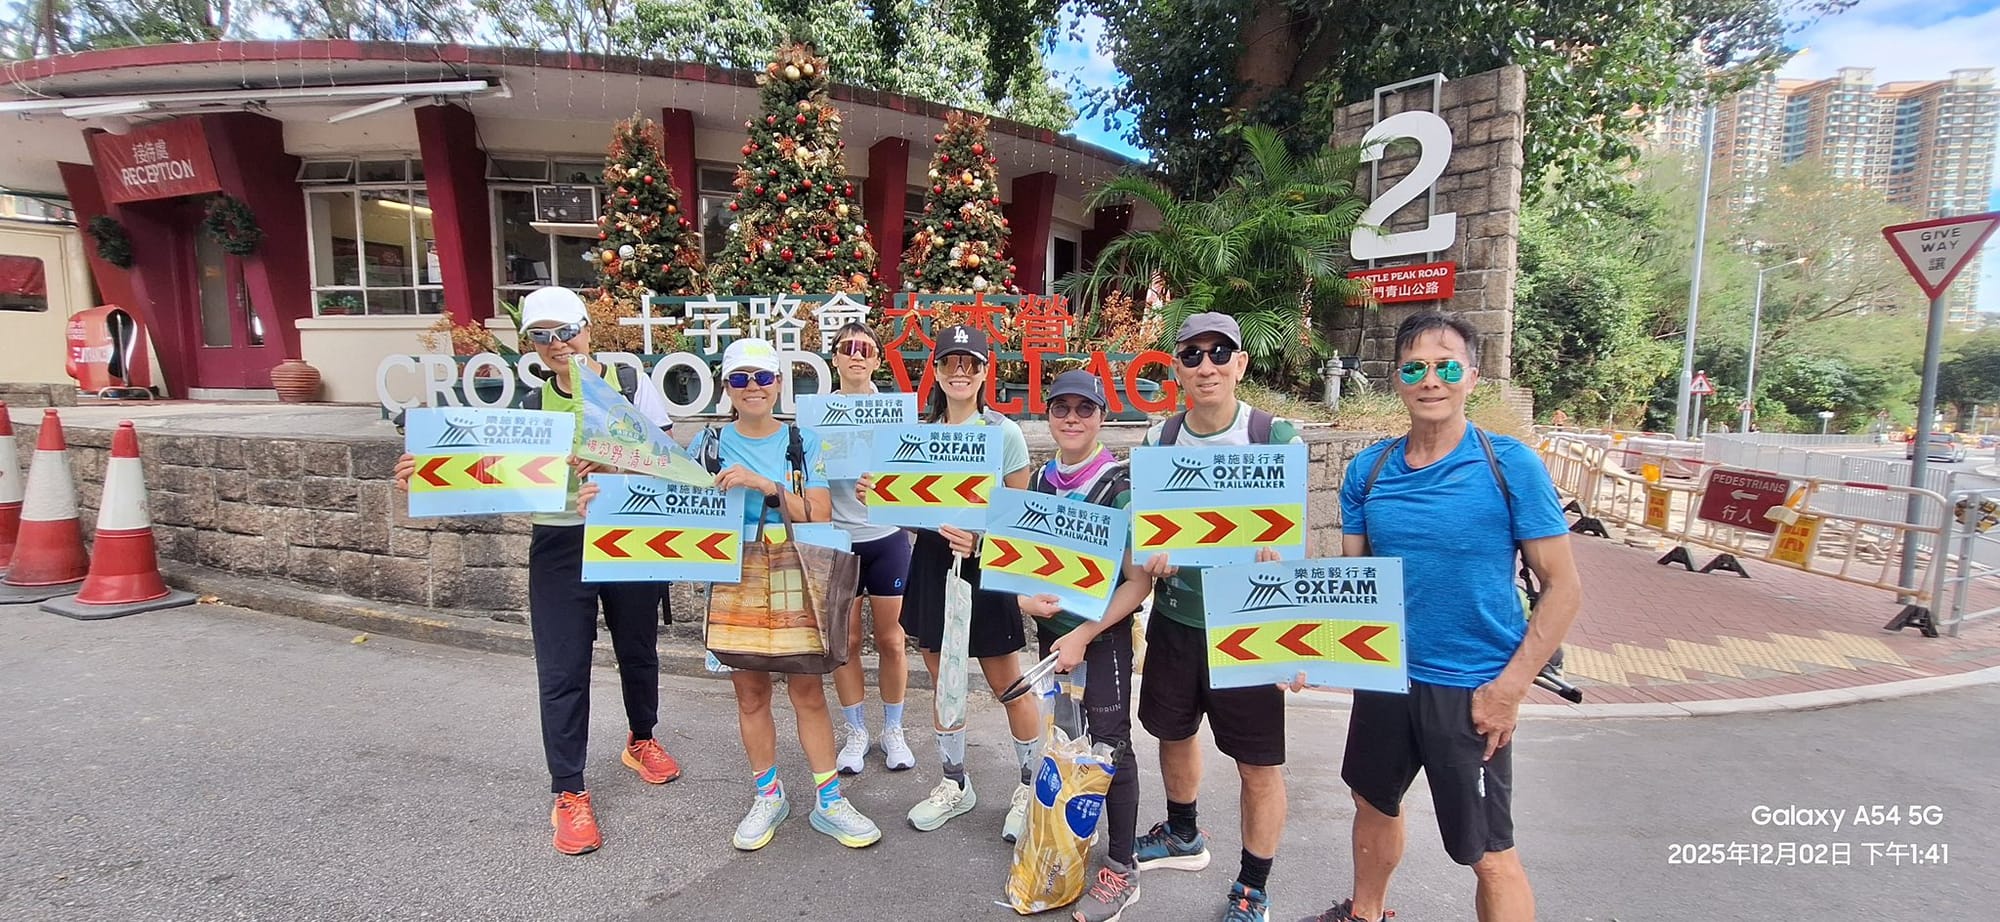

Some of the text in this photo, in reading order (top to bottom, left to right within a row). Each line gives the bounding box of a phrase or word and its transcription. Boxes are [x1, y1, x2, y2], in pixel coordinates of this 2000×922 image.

[121, 159, 195, 186] RECEPTION
[1350, 110, 1456, 261] 2
[1921, 228, 1960, 241] GIVE
[1921, 240, 1959, 253] WAY
[1391, 270, 1416, 281] PEAK
[1418, 267, 1448, 278] ROAD
[953, 325, 969, 343] LA
[854, 407, 903, 418] OXFAM
[855, 417, 904, 425] TRAILWALKER
[483, 425, 551, 438] OXFAM
[930, 432, 987, 442] 樂施毅行者
[483, 437, 551, 445] TRAILWALKER
[929, 442, 986, 455] OXFAM
[929, 454, 986, 463] TRAILWALKER
[1213, 453, 1285, 465] 樂施毅行者
[1212, 465, 1285, 480] OXFAM
[1213, 480, 1285, 489] TRAILWALKER
[1712, 473, 1787, 493] PEDESTRIANS
[665, 493, 726, 509] OXFAM
[666, 506, 726, 516] TRAILWALKER
[1722, 504, 1753, 525] 行人
[1055, 515, 1109, 539] OXFAM
[1055, 528, 1108, 547] TRAILWALKER
[1294, 566, 1377, 579] 樂施毅行者
[1294, 579, 1378, 595] OXFAM
[1295, 595, 1378, 604] TRAILWALKER
